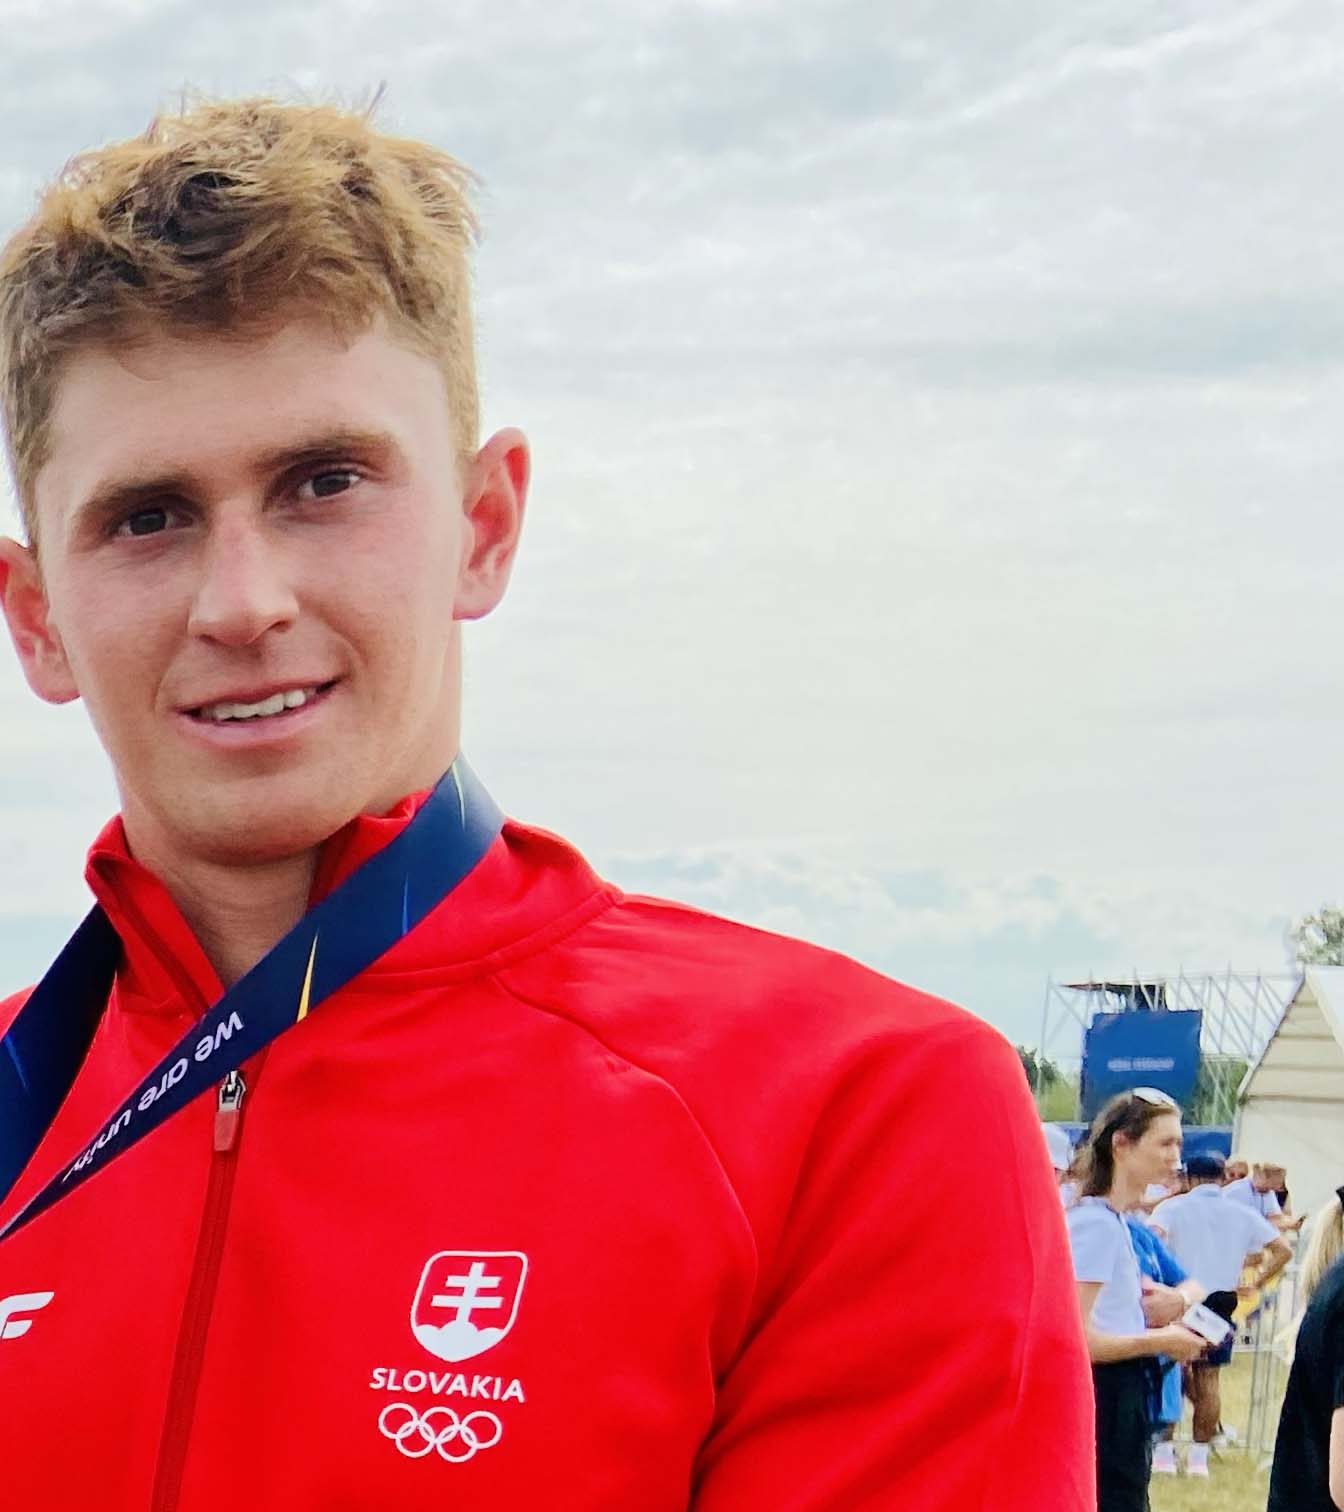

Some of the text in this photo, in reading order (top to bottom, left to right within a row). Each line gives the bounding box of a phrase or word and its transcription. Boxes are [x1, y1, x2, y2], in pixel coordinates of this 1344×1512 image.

[61, 1011, 245, 1184] we are unity
[369, 1367, 526, 1404] SLOVAKIA
